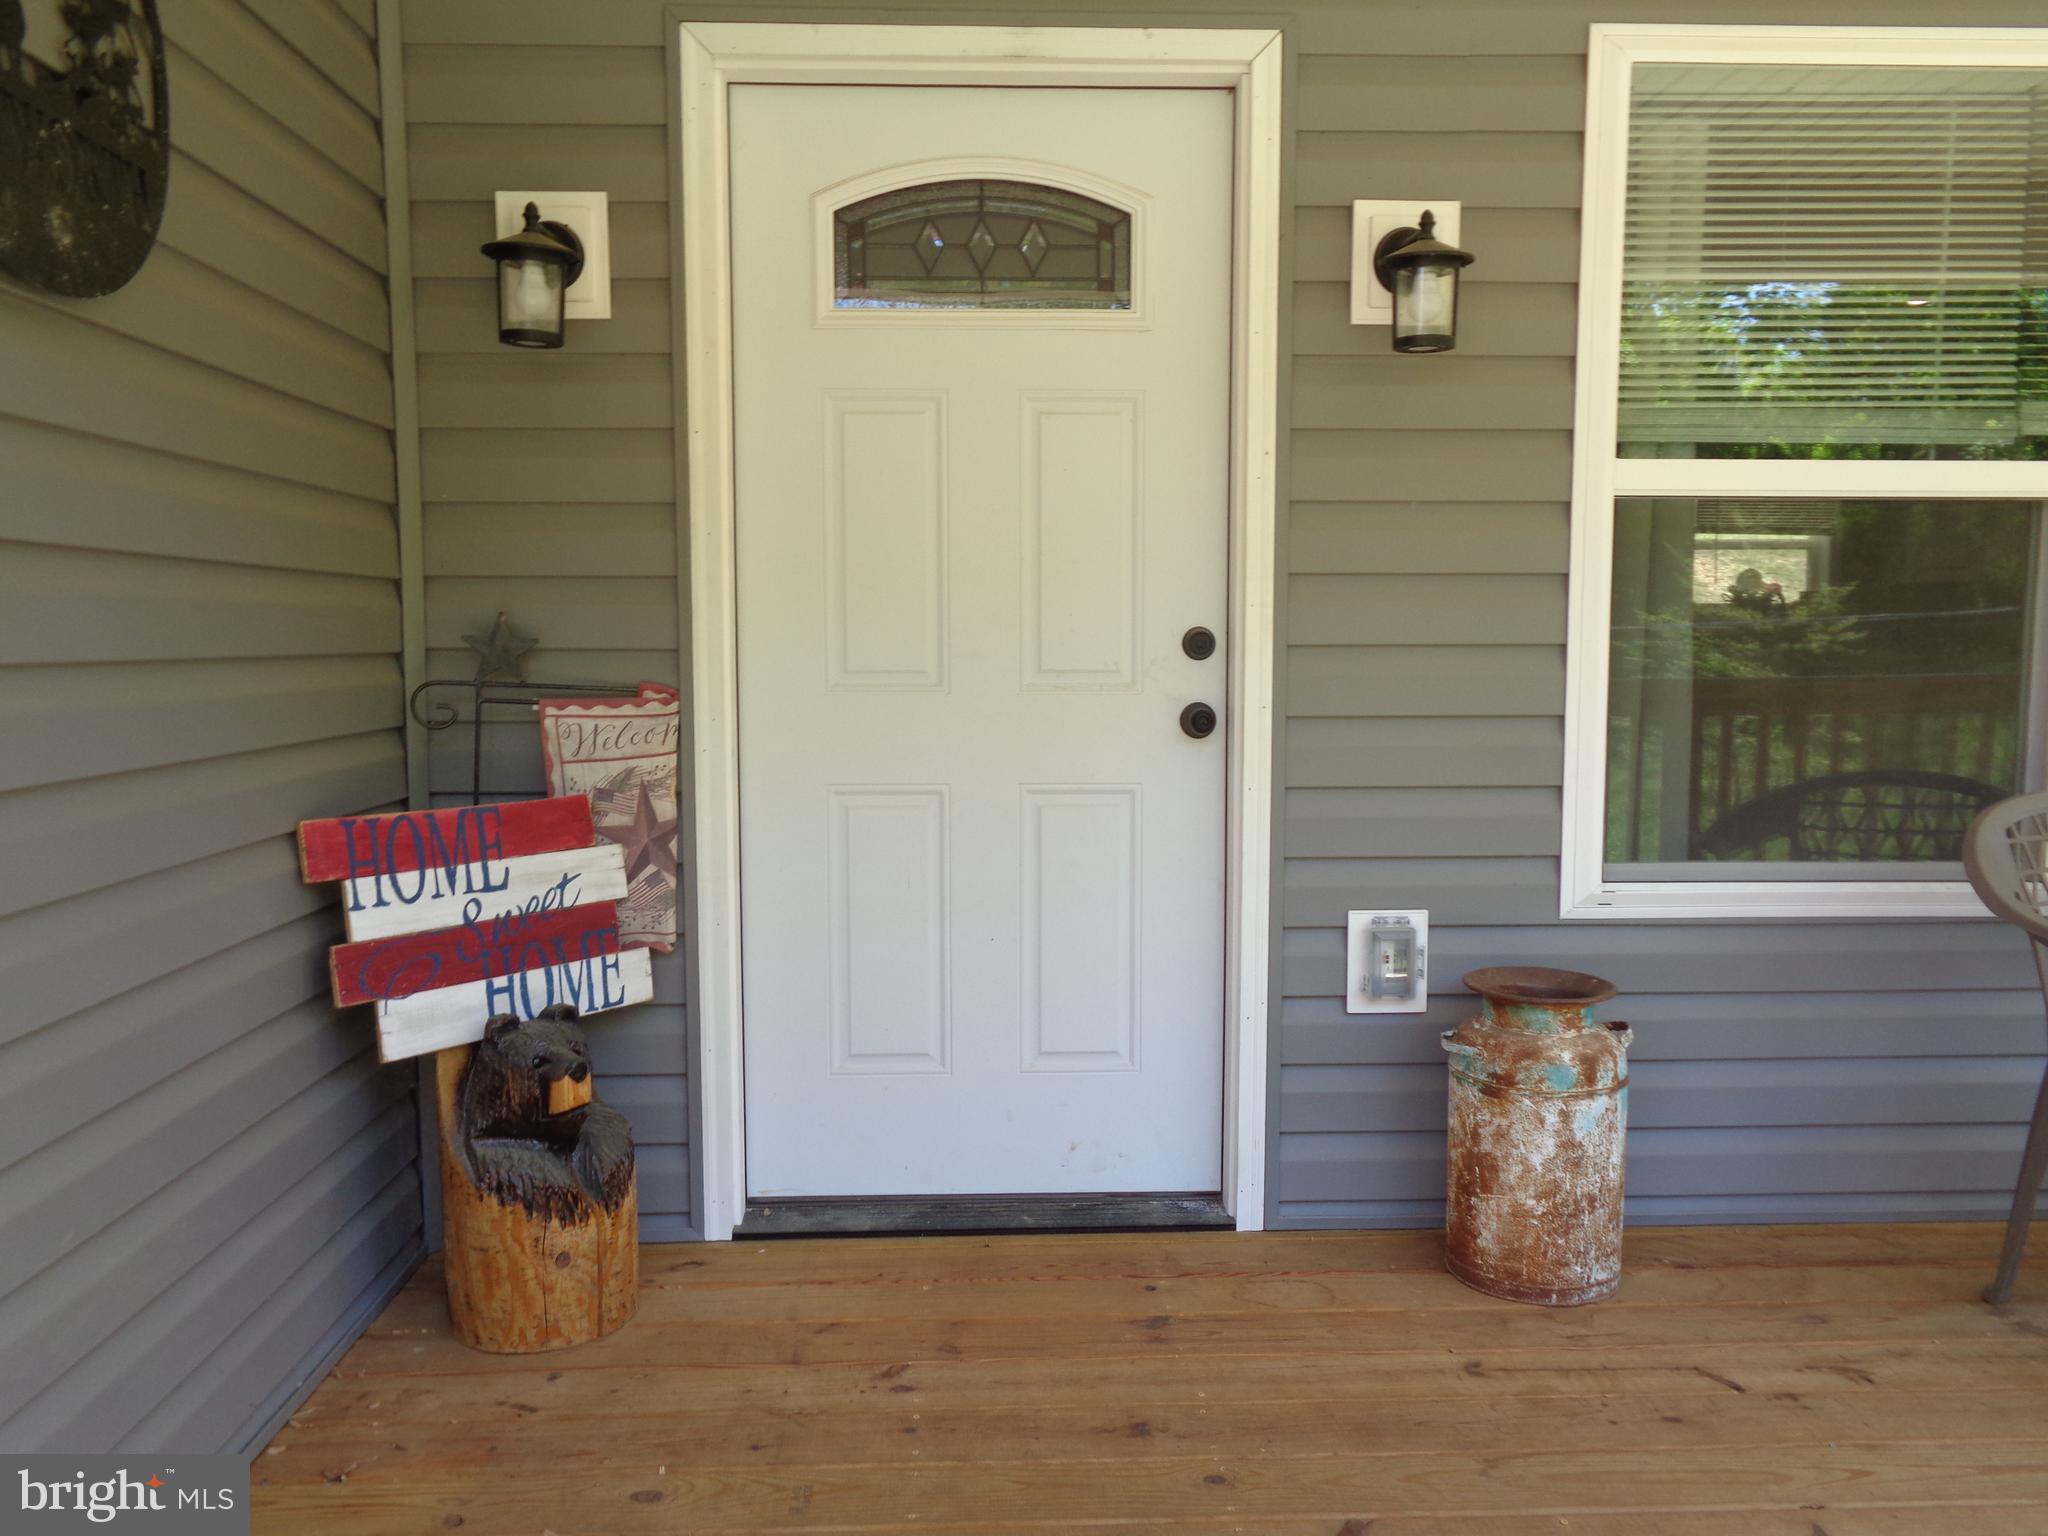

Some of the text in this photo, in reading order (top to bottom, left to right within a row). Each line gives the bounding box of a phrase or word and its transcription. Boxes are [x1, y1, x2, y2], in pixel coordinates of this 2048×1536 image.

[559, 720, 680, 758] Welcom
[340, 805, 511, 912] HOME
[456, 871, 583, 964] Sweet
[479, 926, 626, 1022] HOME
